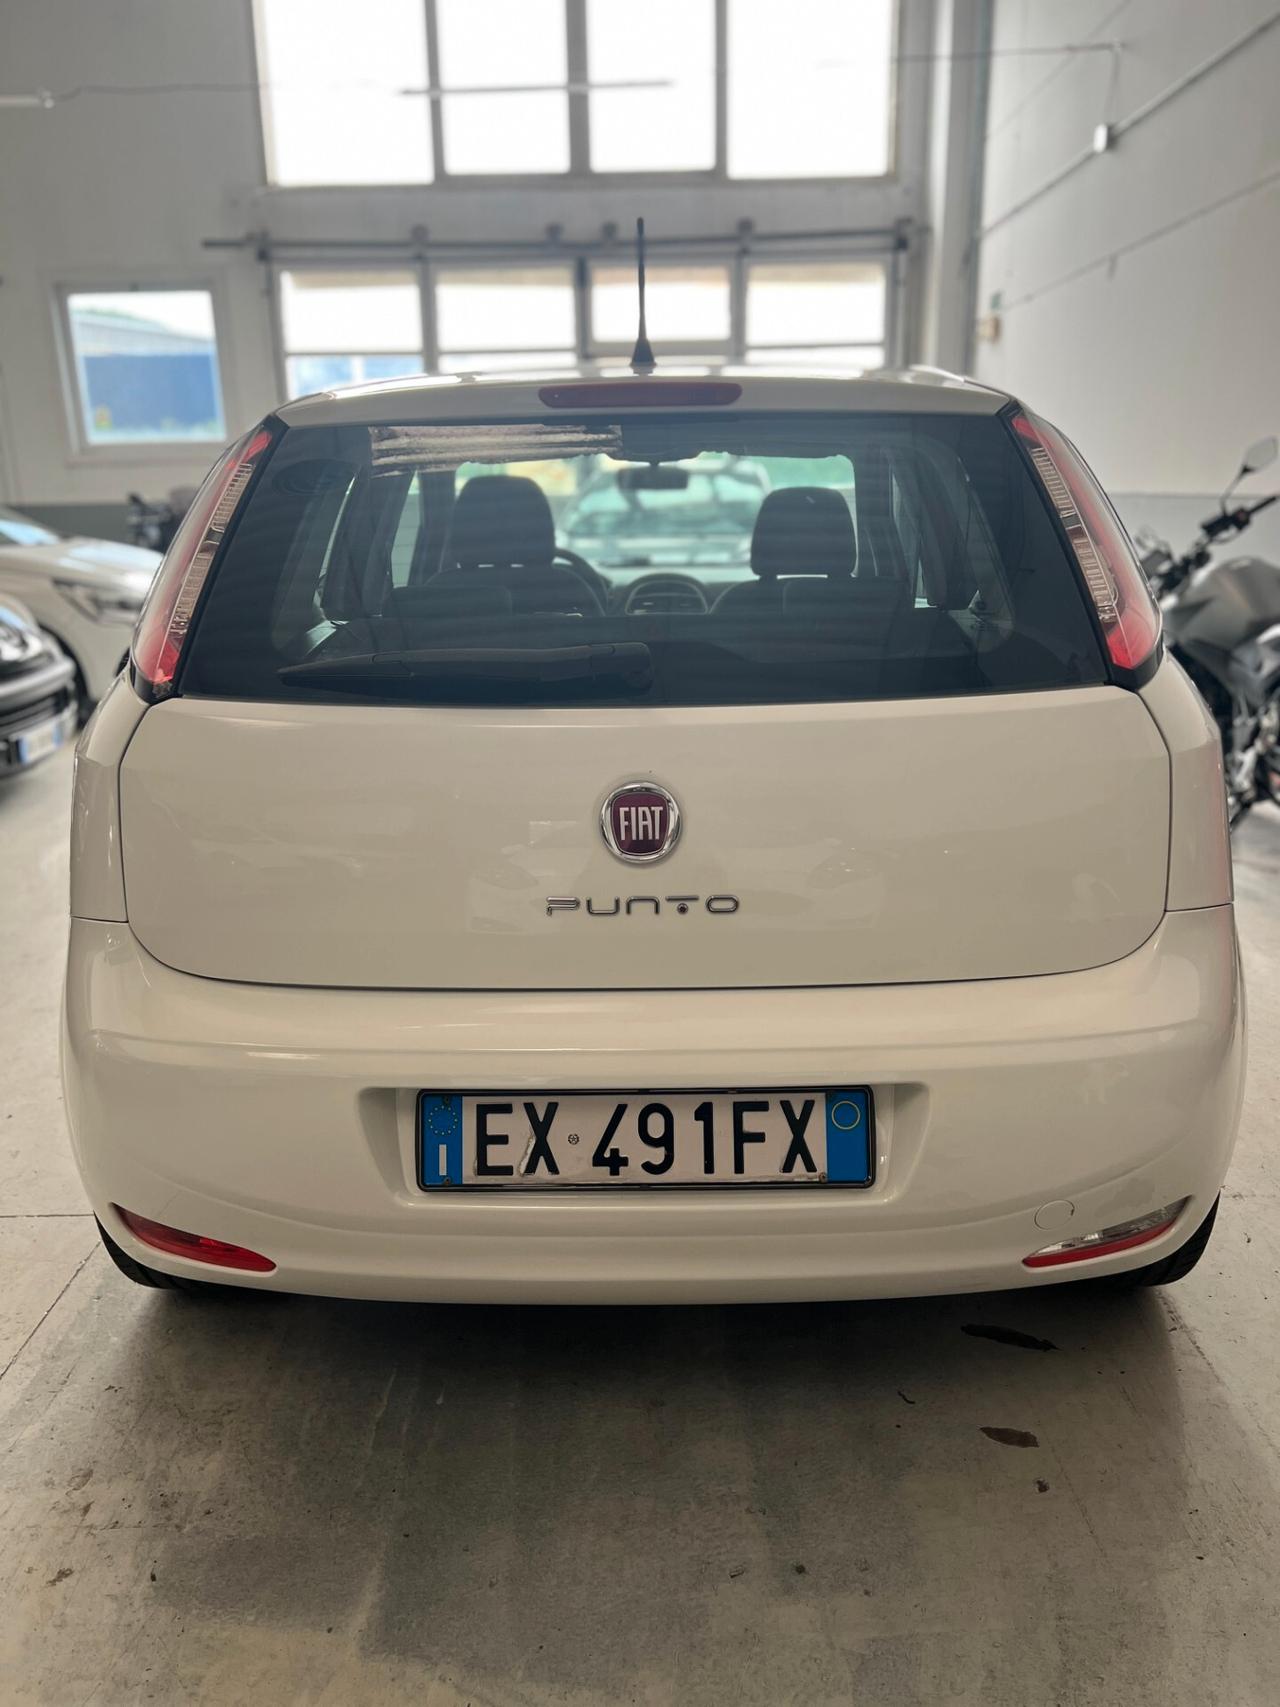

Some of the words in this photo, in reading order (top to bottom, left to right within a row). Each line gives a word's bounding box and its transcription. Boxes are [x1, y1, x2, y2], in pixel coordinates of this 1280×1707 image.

[619, 806, 664, 841] FIAT
[546, 894, 740, 916] PUNTO
[475, 1101, 561, 1177] EX
[591, 1099, 819, 1177] 491FX
